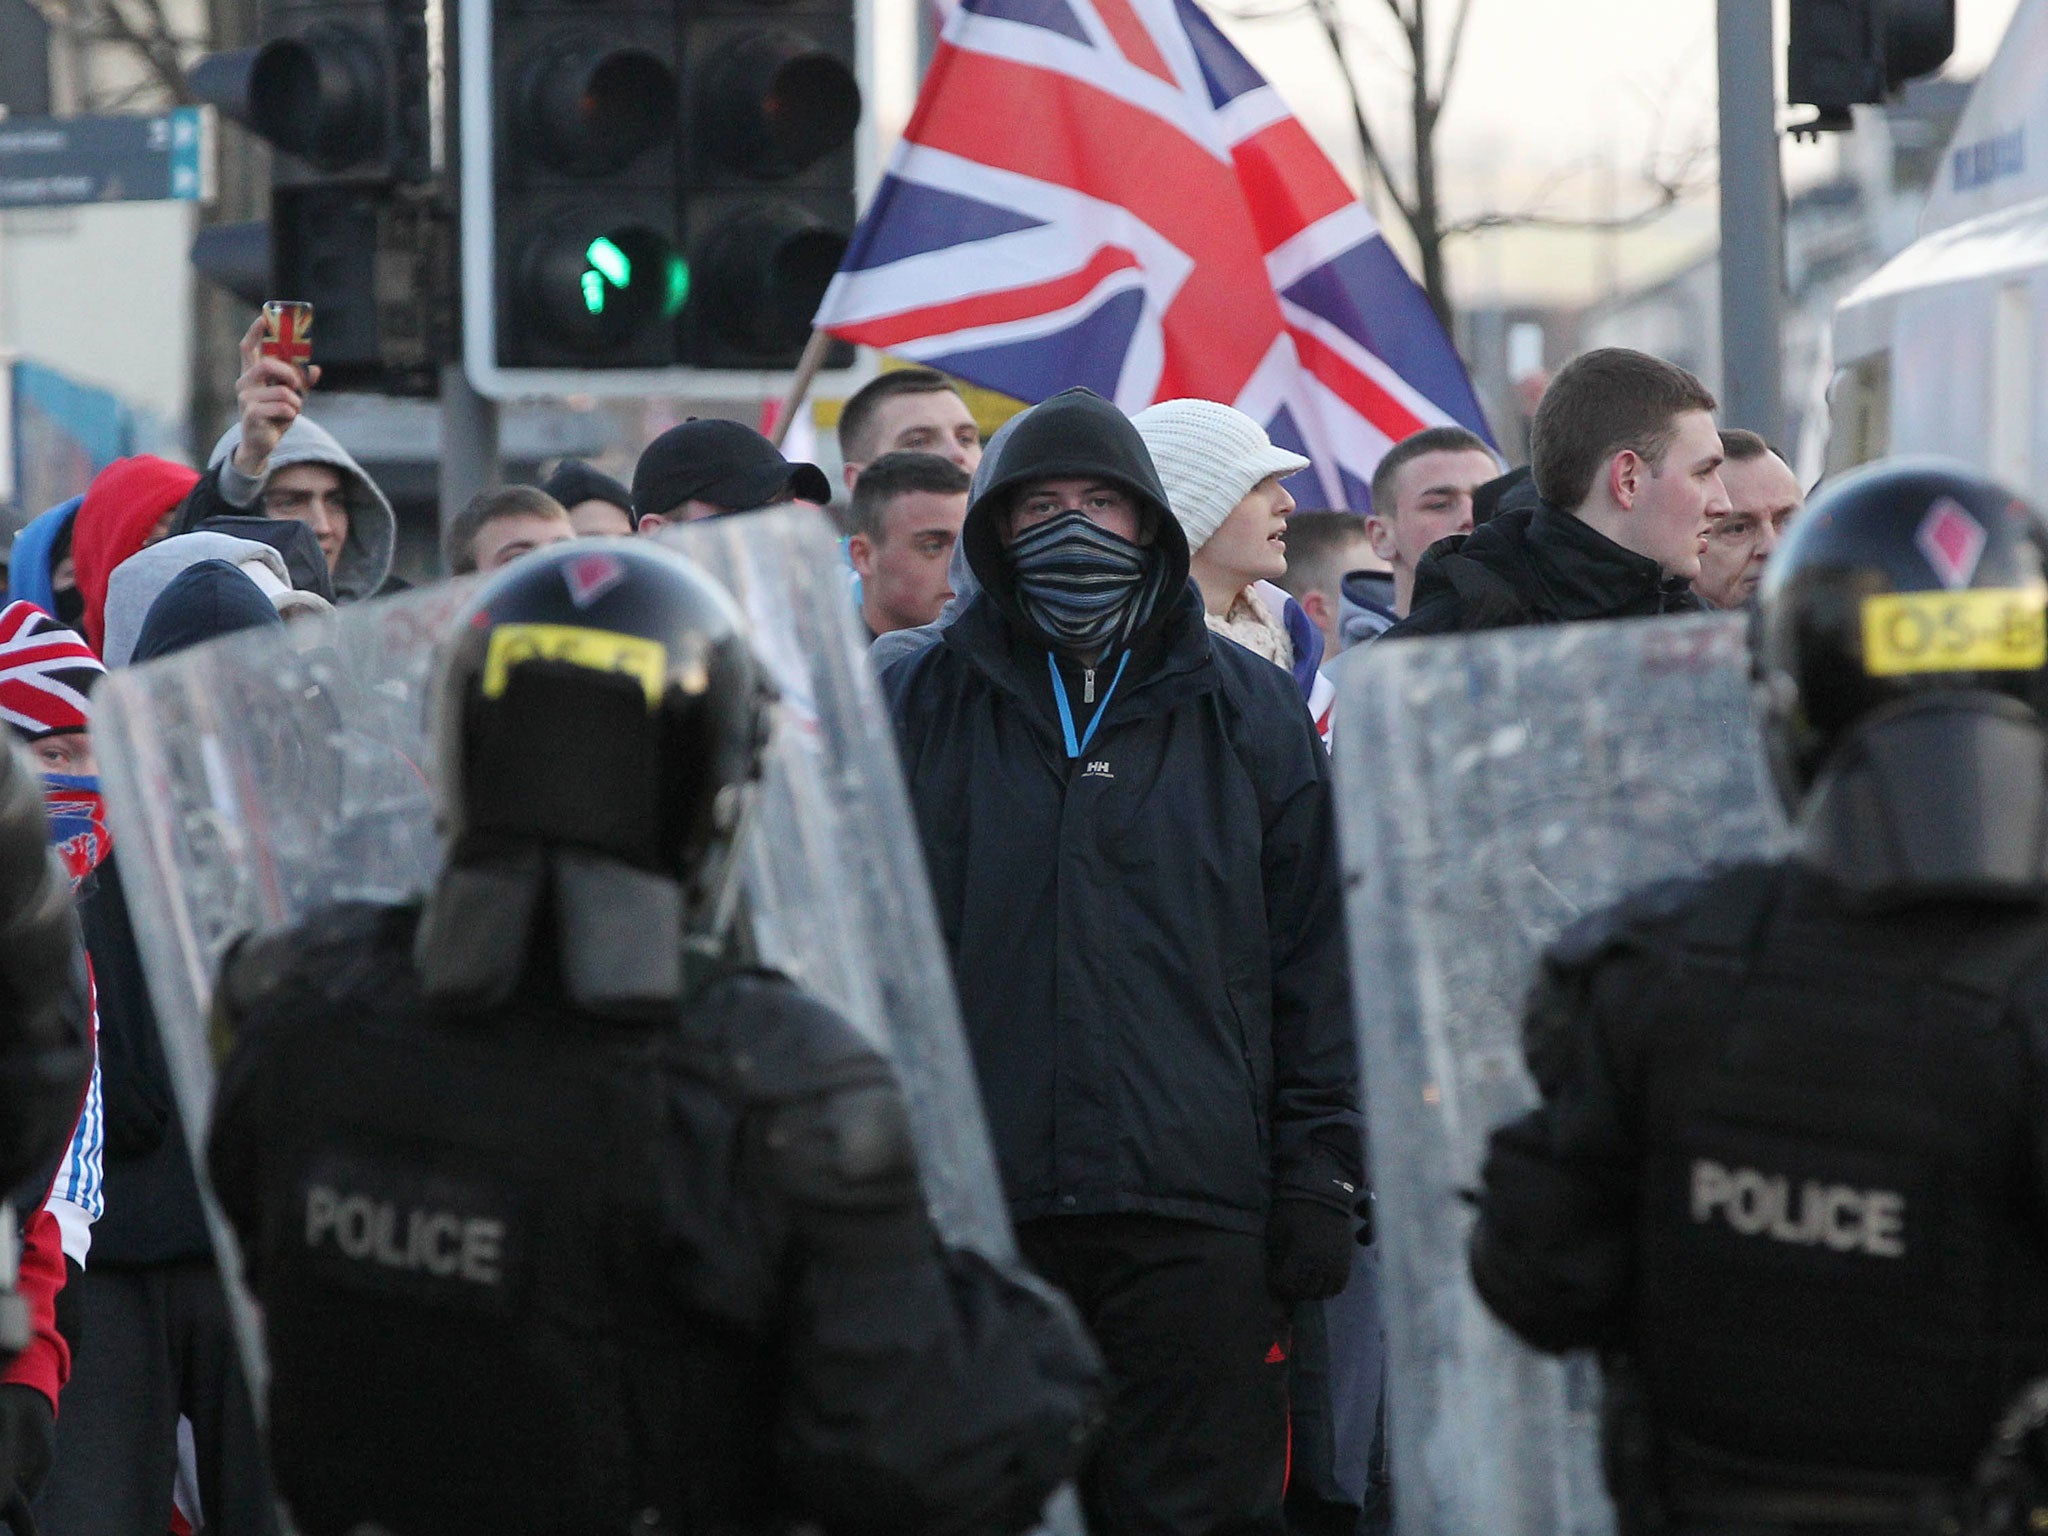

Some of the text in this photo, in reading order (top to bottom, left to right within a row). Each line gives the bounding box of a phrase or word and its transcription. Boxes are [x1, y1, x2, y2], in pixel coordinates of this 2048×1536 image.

[1086, 761, 1110, 773] HH
[304, 1185, 503, 1285] POLICE
[1691, 1159, 1905, 1258] POLICE
